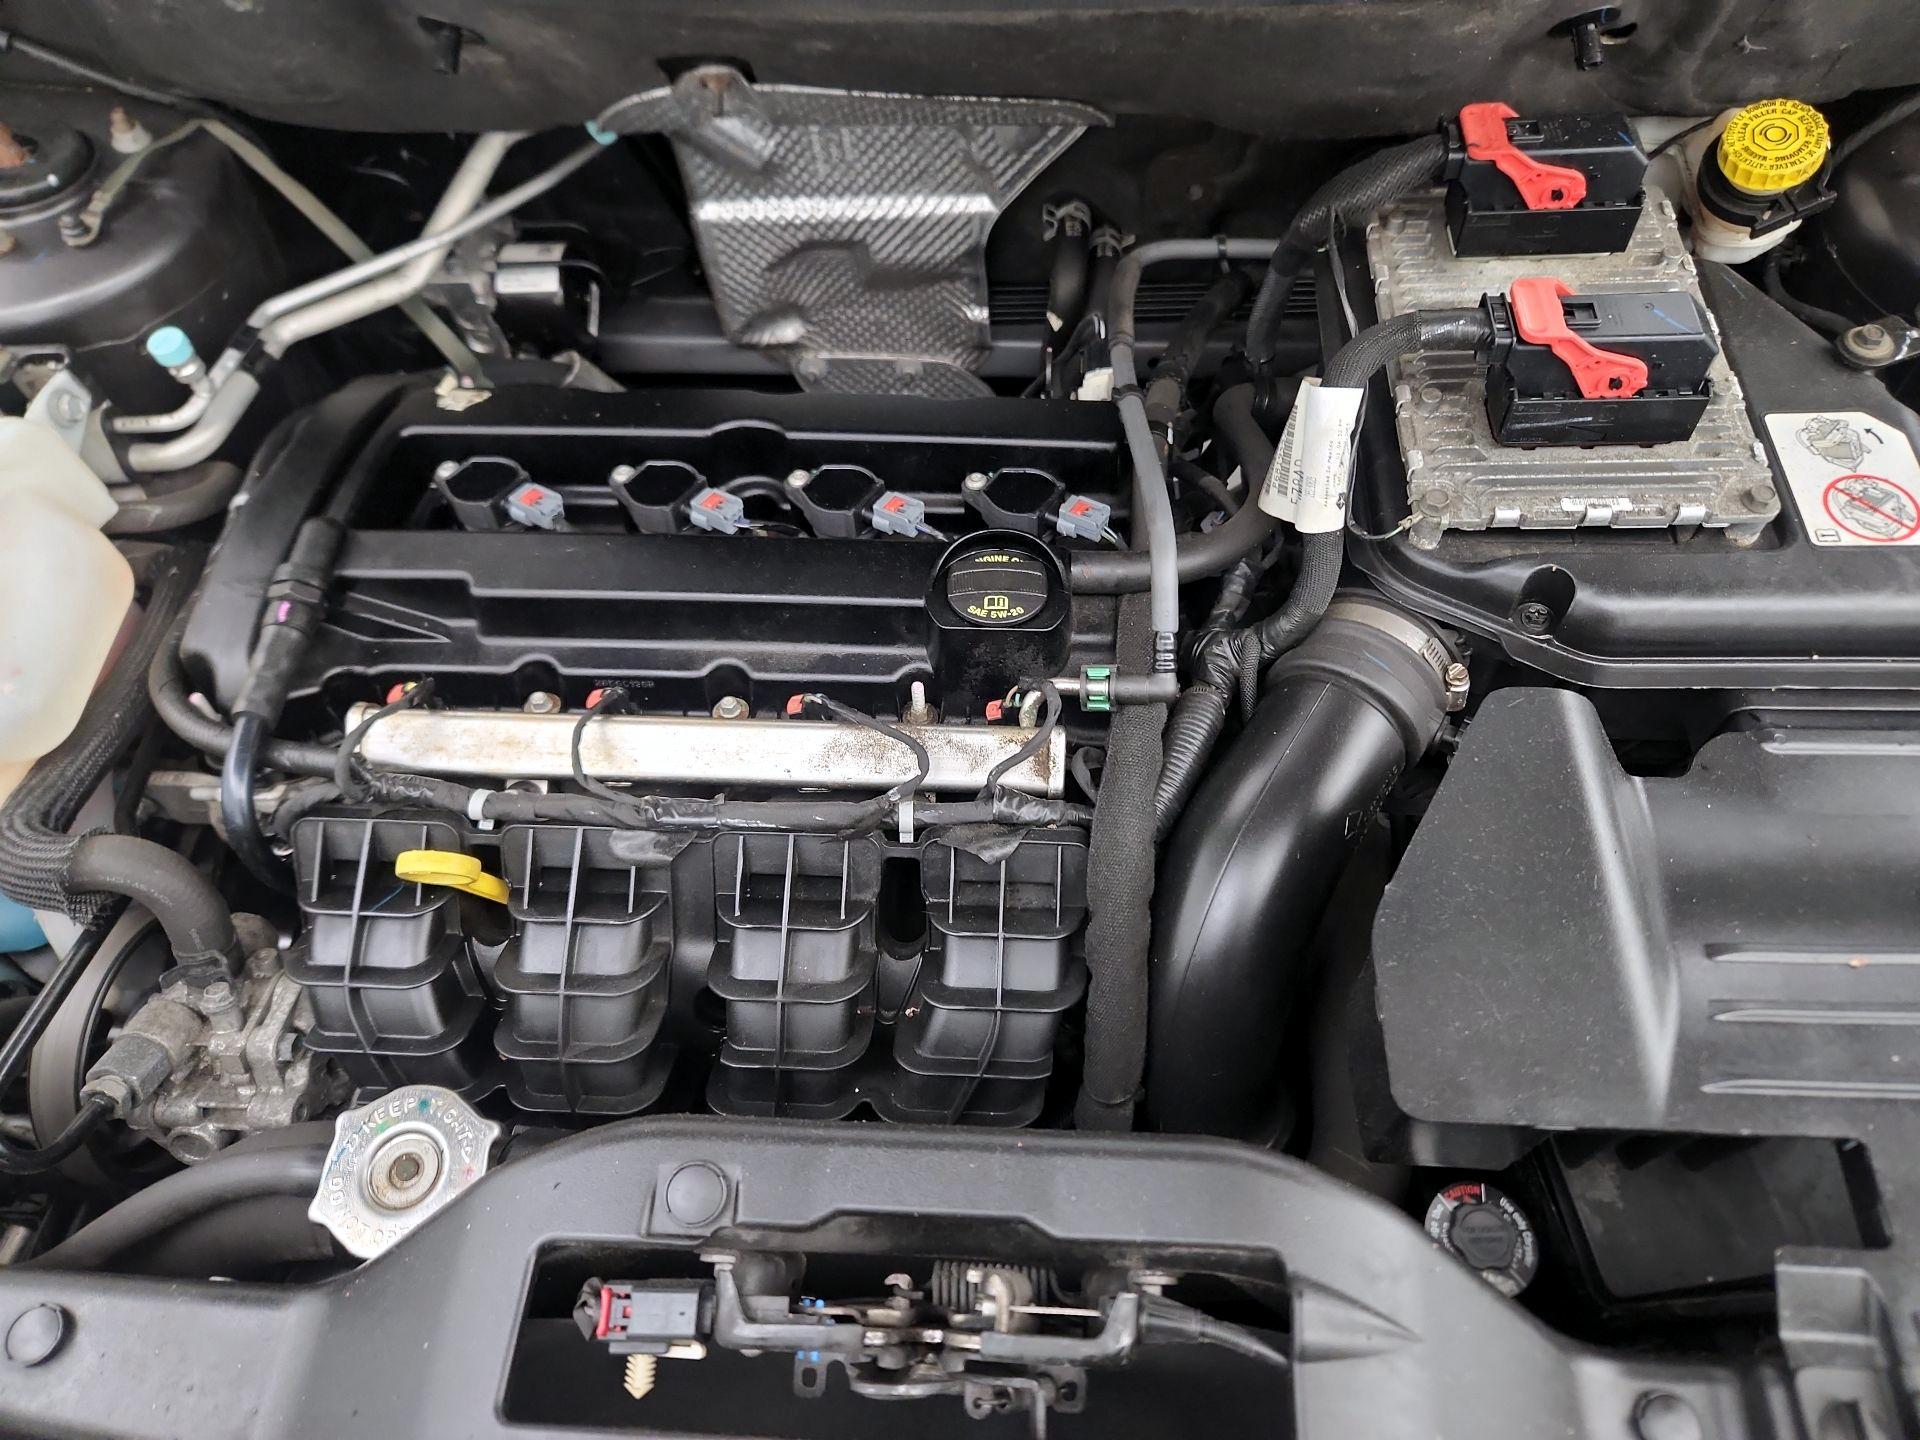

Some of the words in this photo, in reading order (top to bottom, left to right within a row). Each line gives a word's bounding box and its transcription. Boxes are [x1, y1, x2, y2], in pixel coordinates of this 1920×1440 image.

[1749, 108, 1778, 122] FILLER
[1781, 108, 1798, 117] CAP
[1737, 122, 1751, 142] CLEAN
[1774, 140, 1811, 163] REMOVING
[967, 605, 988, 617] SAE
[990, 606, 1025, 619] 5W-20
[361, 1097, 418, 1133] KEEP
[1444, 1185, 1480, 1199] CAUTION
[1499, 1196, 1515, 1214] Use
